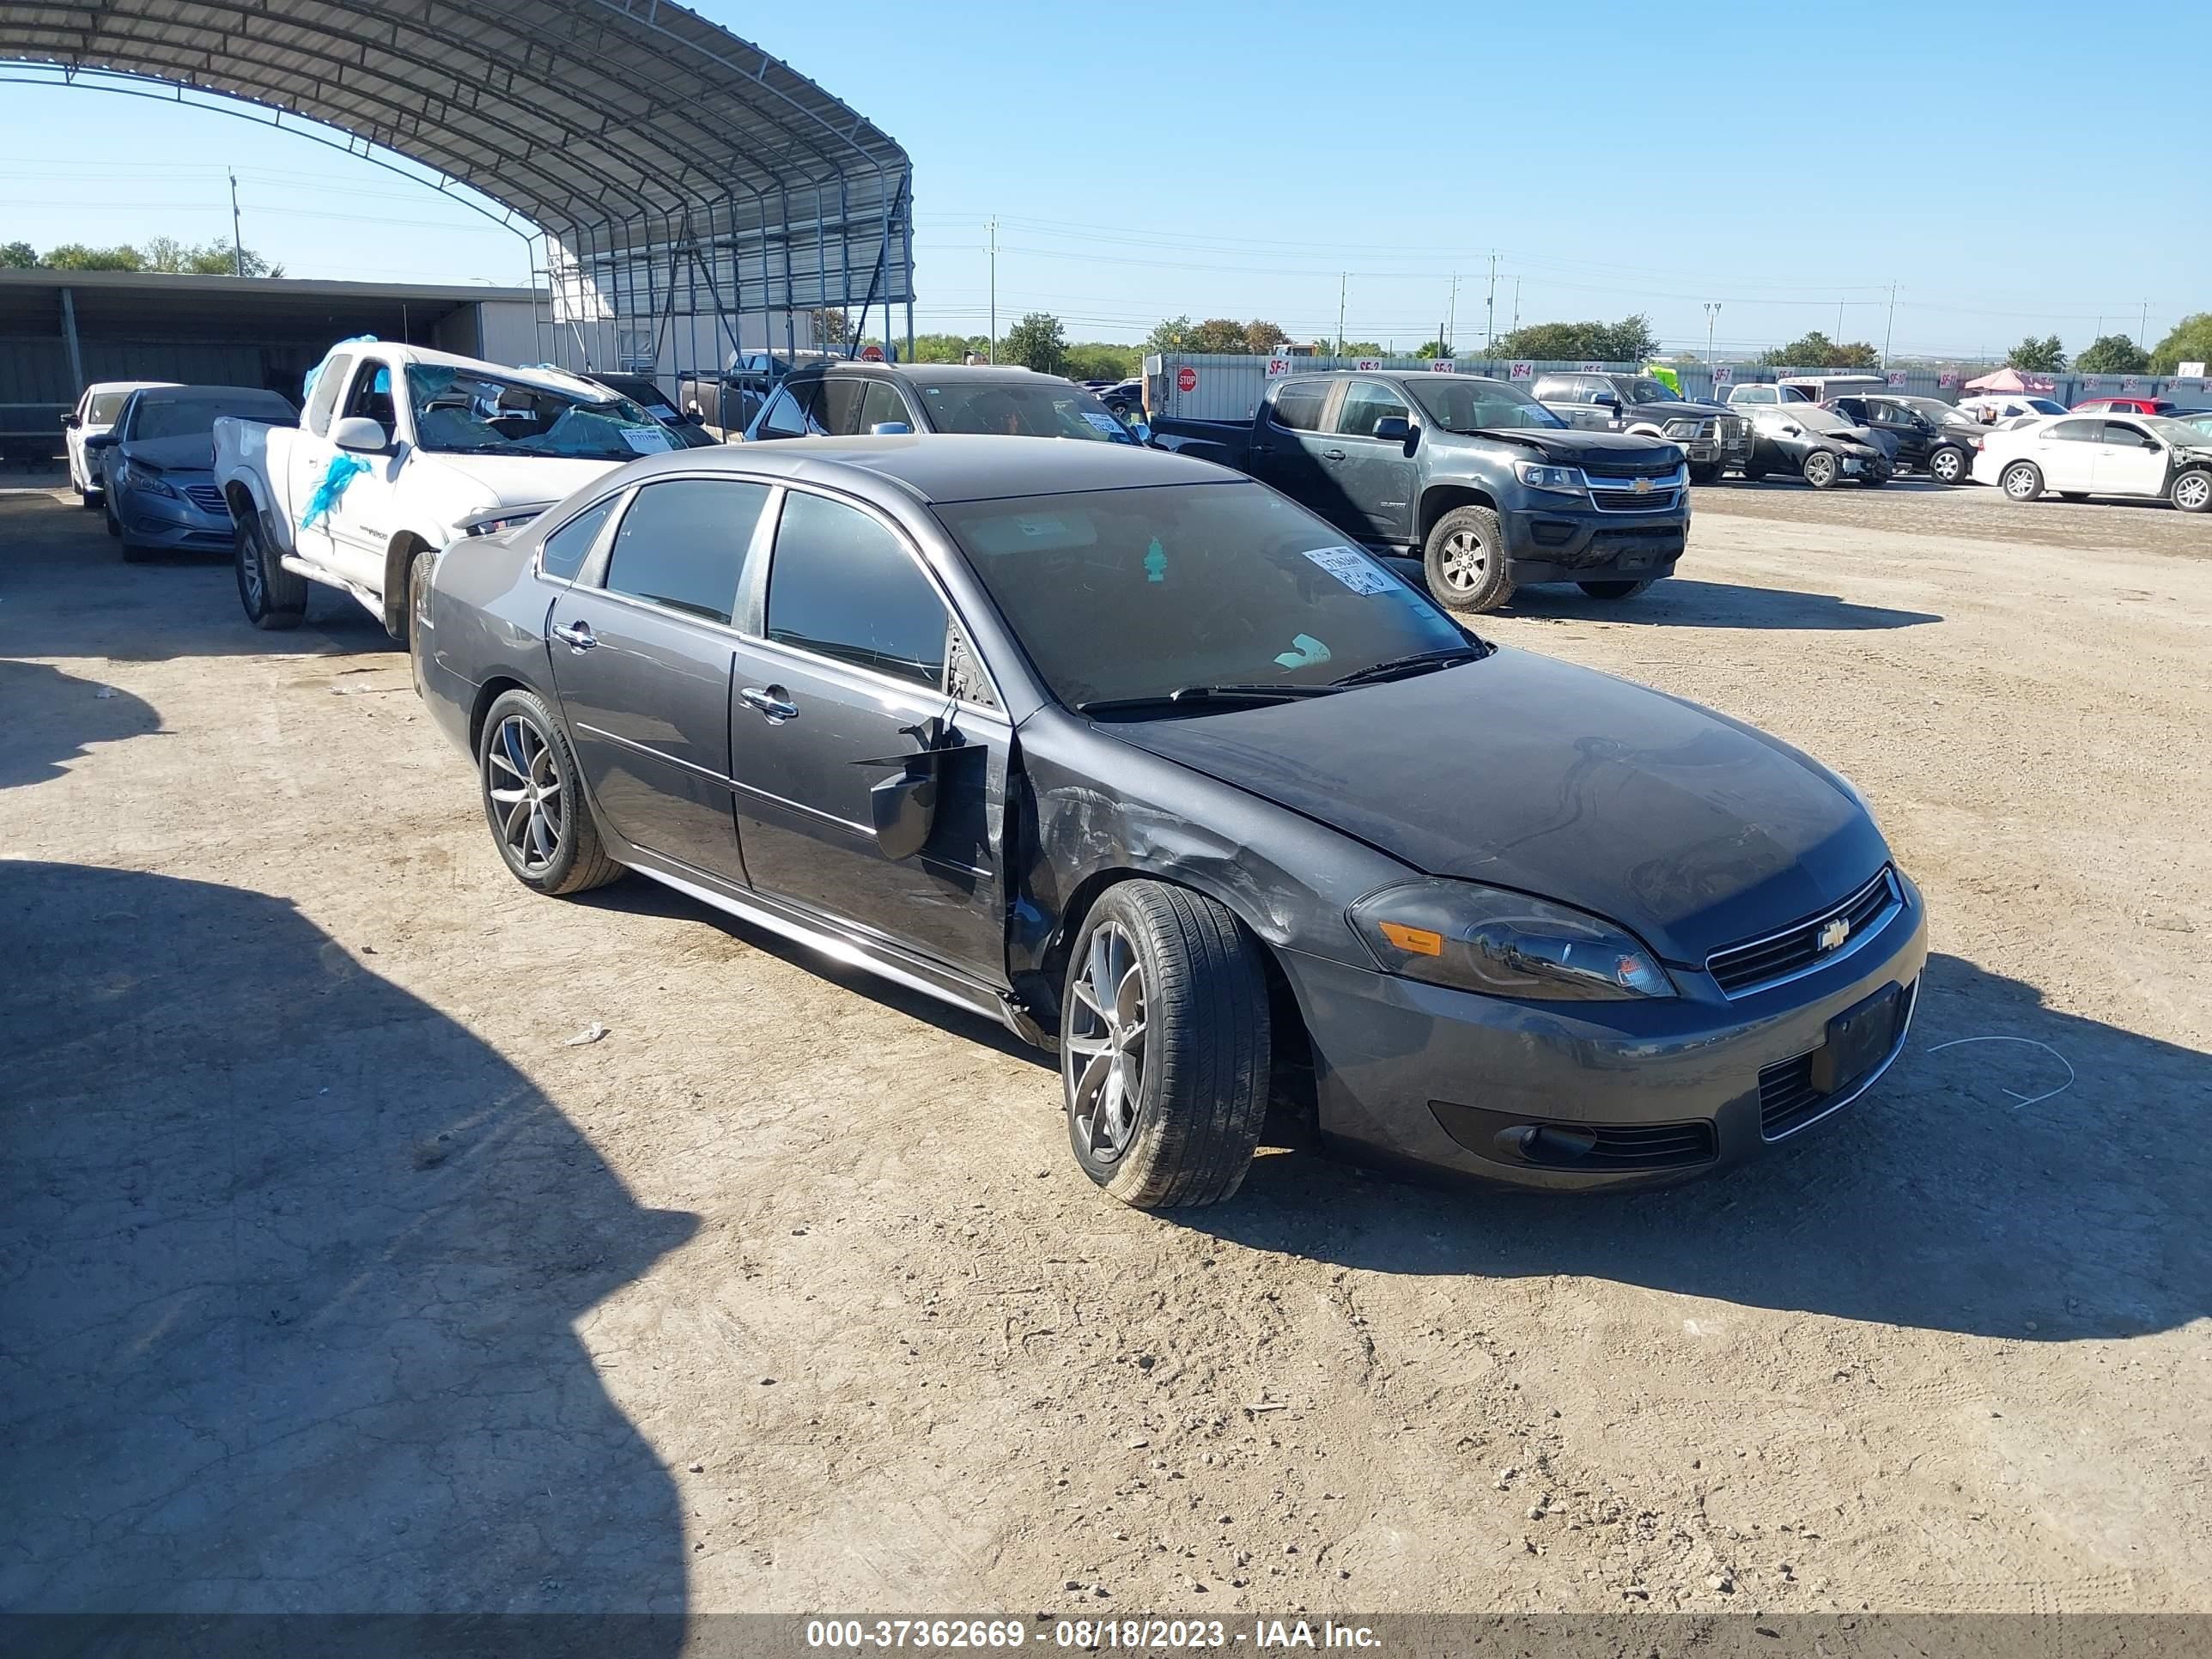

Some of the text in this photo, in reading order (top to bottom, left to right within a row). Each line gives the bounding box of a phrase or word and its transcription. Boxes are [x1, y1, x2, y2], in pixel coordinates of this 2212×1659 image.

[1269, 361, 1290, 374] SF-1
[1512, 364, 1531, 377] SF-4
[1178, 375, 1196, 386] STOP
